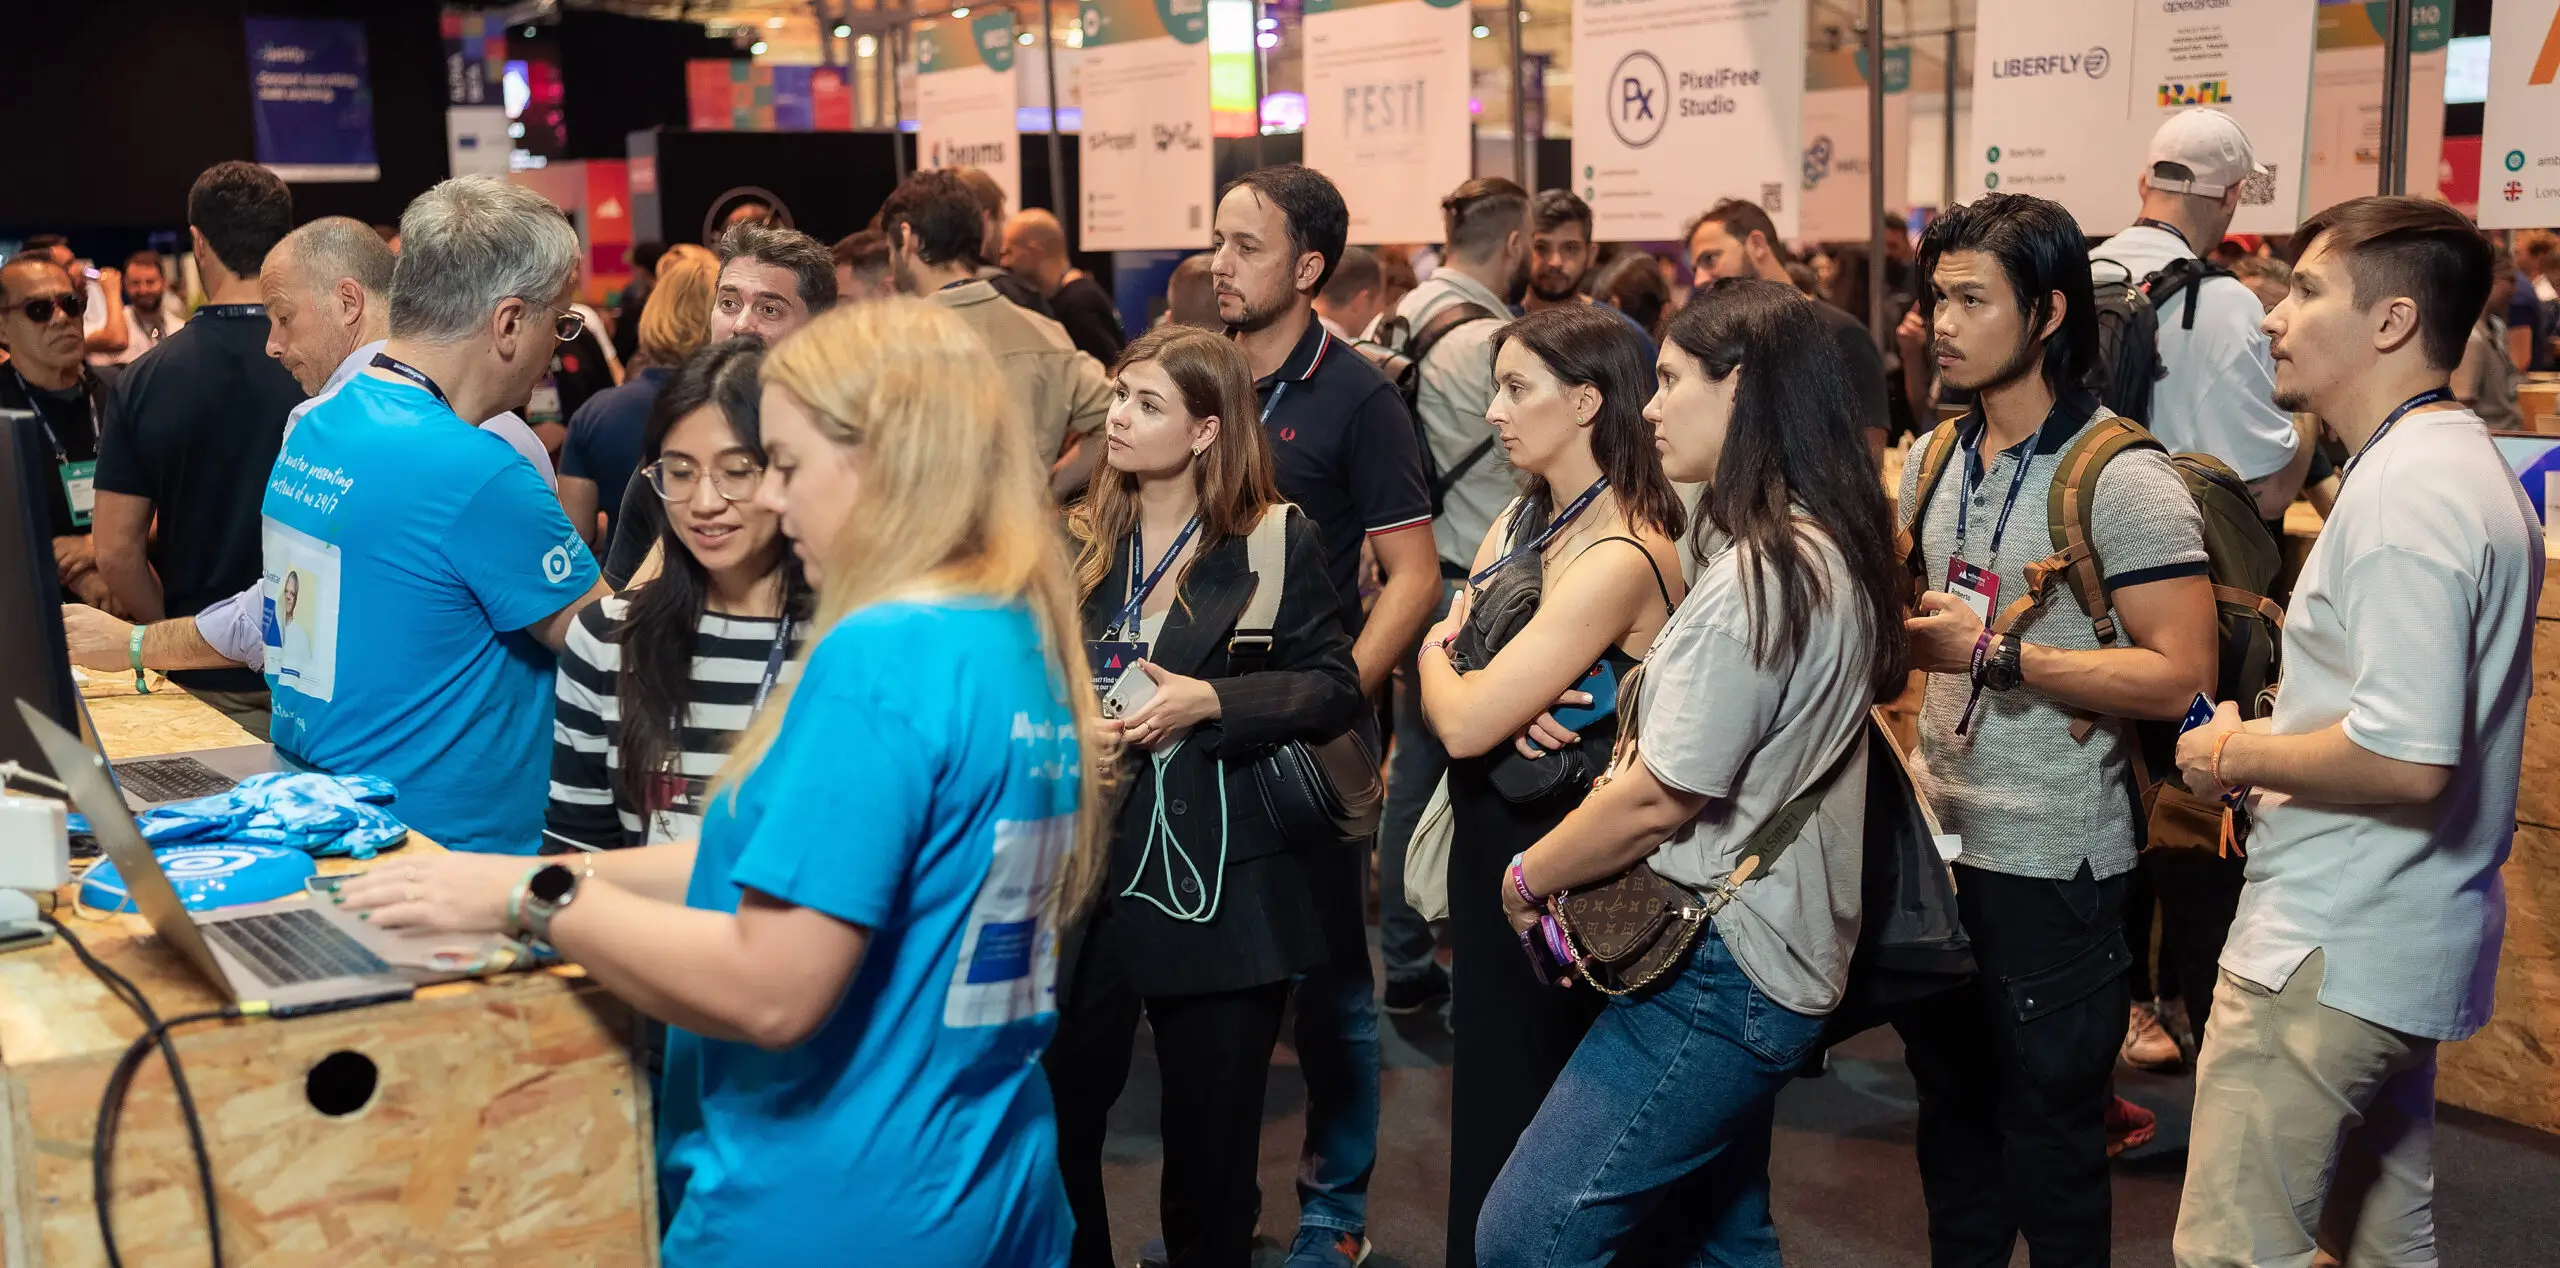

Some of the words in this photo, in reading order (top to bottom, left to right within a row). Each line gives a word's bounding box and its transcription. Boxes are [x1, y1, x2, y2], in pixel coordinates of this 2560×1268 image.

[1679, 67, 1761, 91] PixelFree
[1993, 54, 2081, 79] LIBERFLY
[1679, 95, 1736, 117] Studio
[2158, 80, 2232, 108] BRASIL
[306, 464, 354, 495] presenting
[1158, 545, 1179, 572] websummit
[1971, 648, 1983, 680] PARTNER
[1765, 812, 1801, 850] LOUIS
